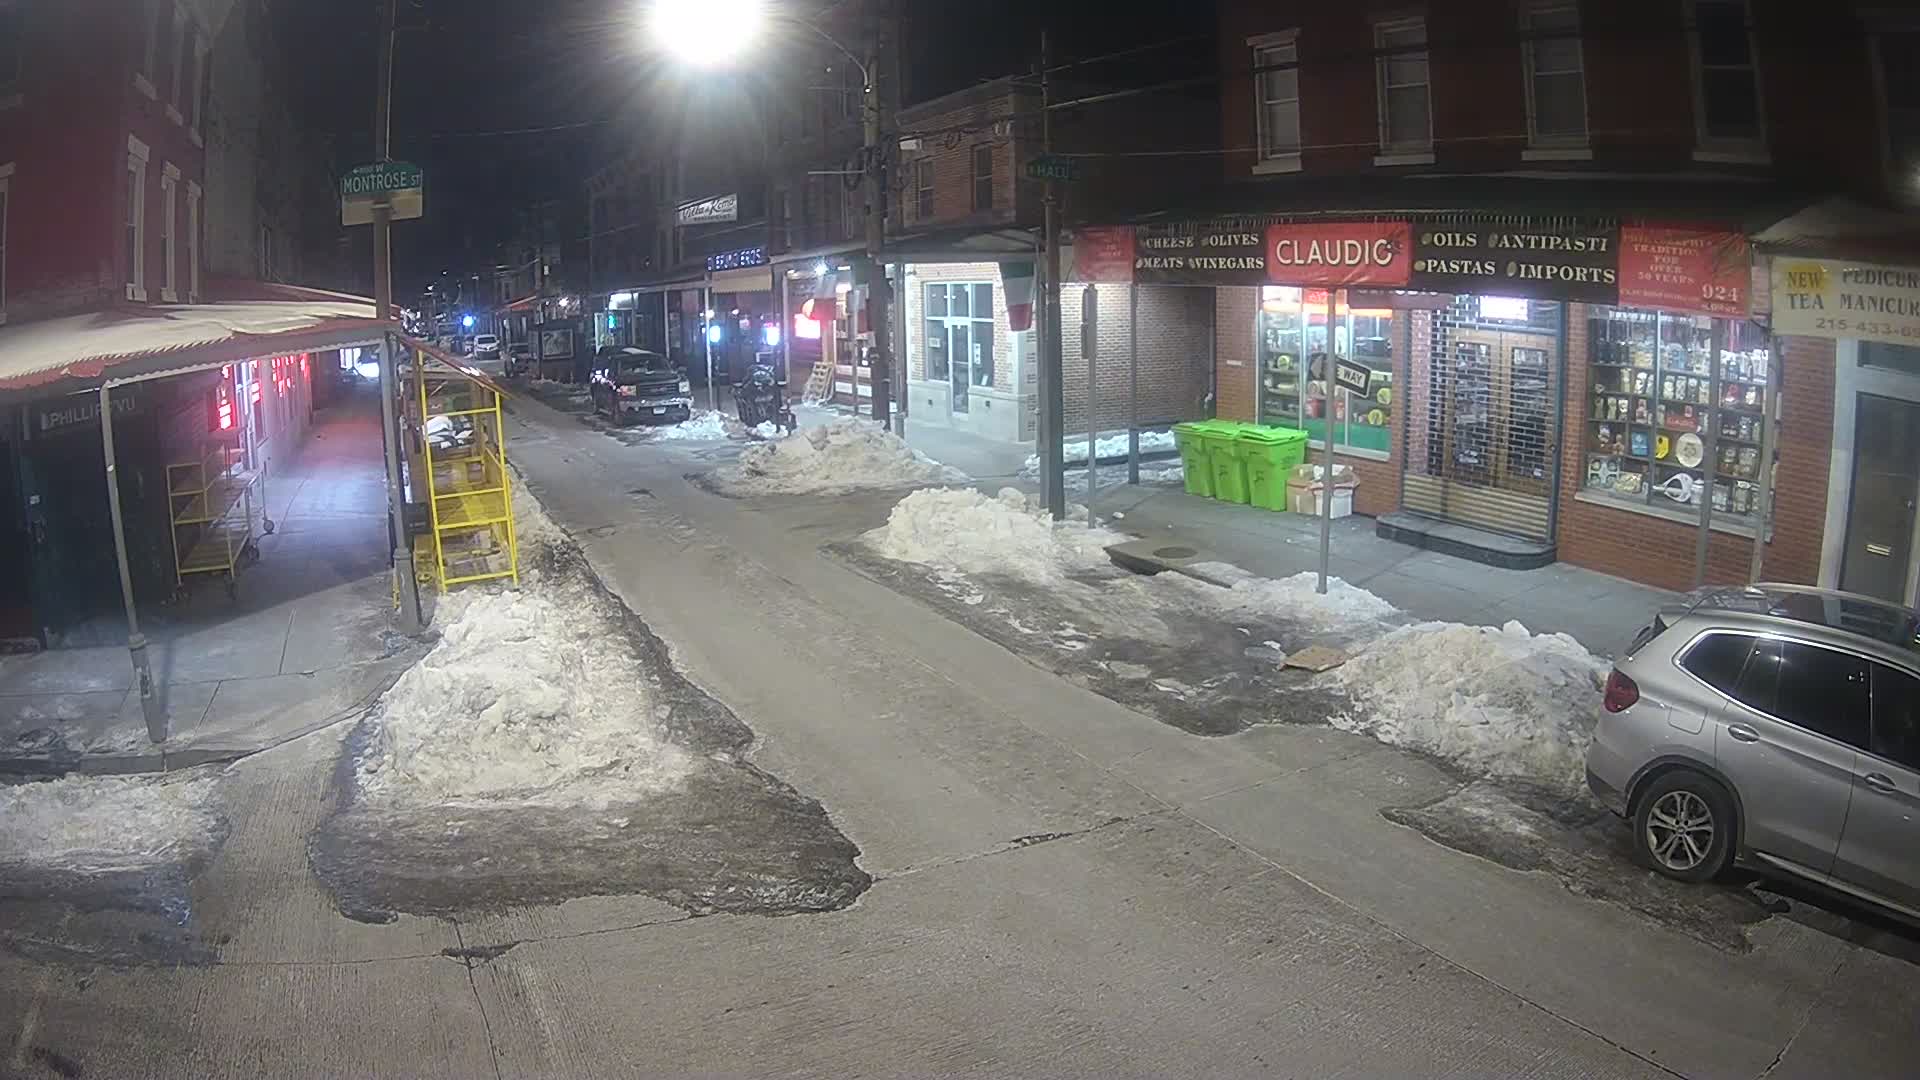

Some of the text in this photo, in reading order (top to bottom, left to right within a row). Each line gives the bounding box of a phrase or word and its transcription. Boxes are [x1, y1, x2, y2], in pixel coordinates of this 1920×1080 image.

[343, 171, 408, 193] MONTROSE
[411, 174, 421, 187] ST
[1145, 233, 1260, 249] CHEESE OLIVES
[1433, 232, 1608, 252] OILS ANTIPASTI
[1144, 256, 1265, 269] MEATS VINEGARS
[1652, 254, 1681, 265] FOR
[1426, 258, 1617, 285] PASTAS IMPORTS
[1649, 263, 1684, 275] OVER
[1655, 273, 1696, 285] YEARS
[1786, 270, 1821, 289] NEW
[1701, 283, 1738, 302] 924
[1786, 293, 1825, 311] TEA
[1343, 368, 1363, 385] WAY
